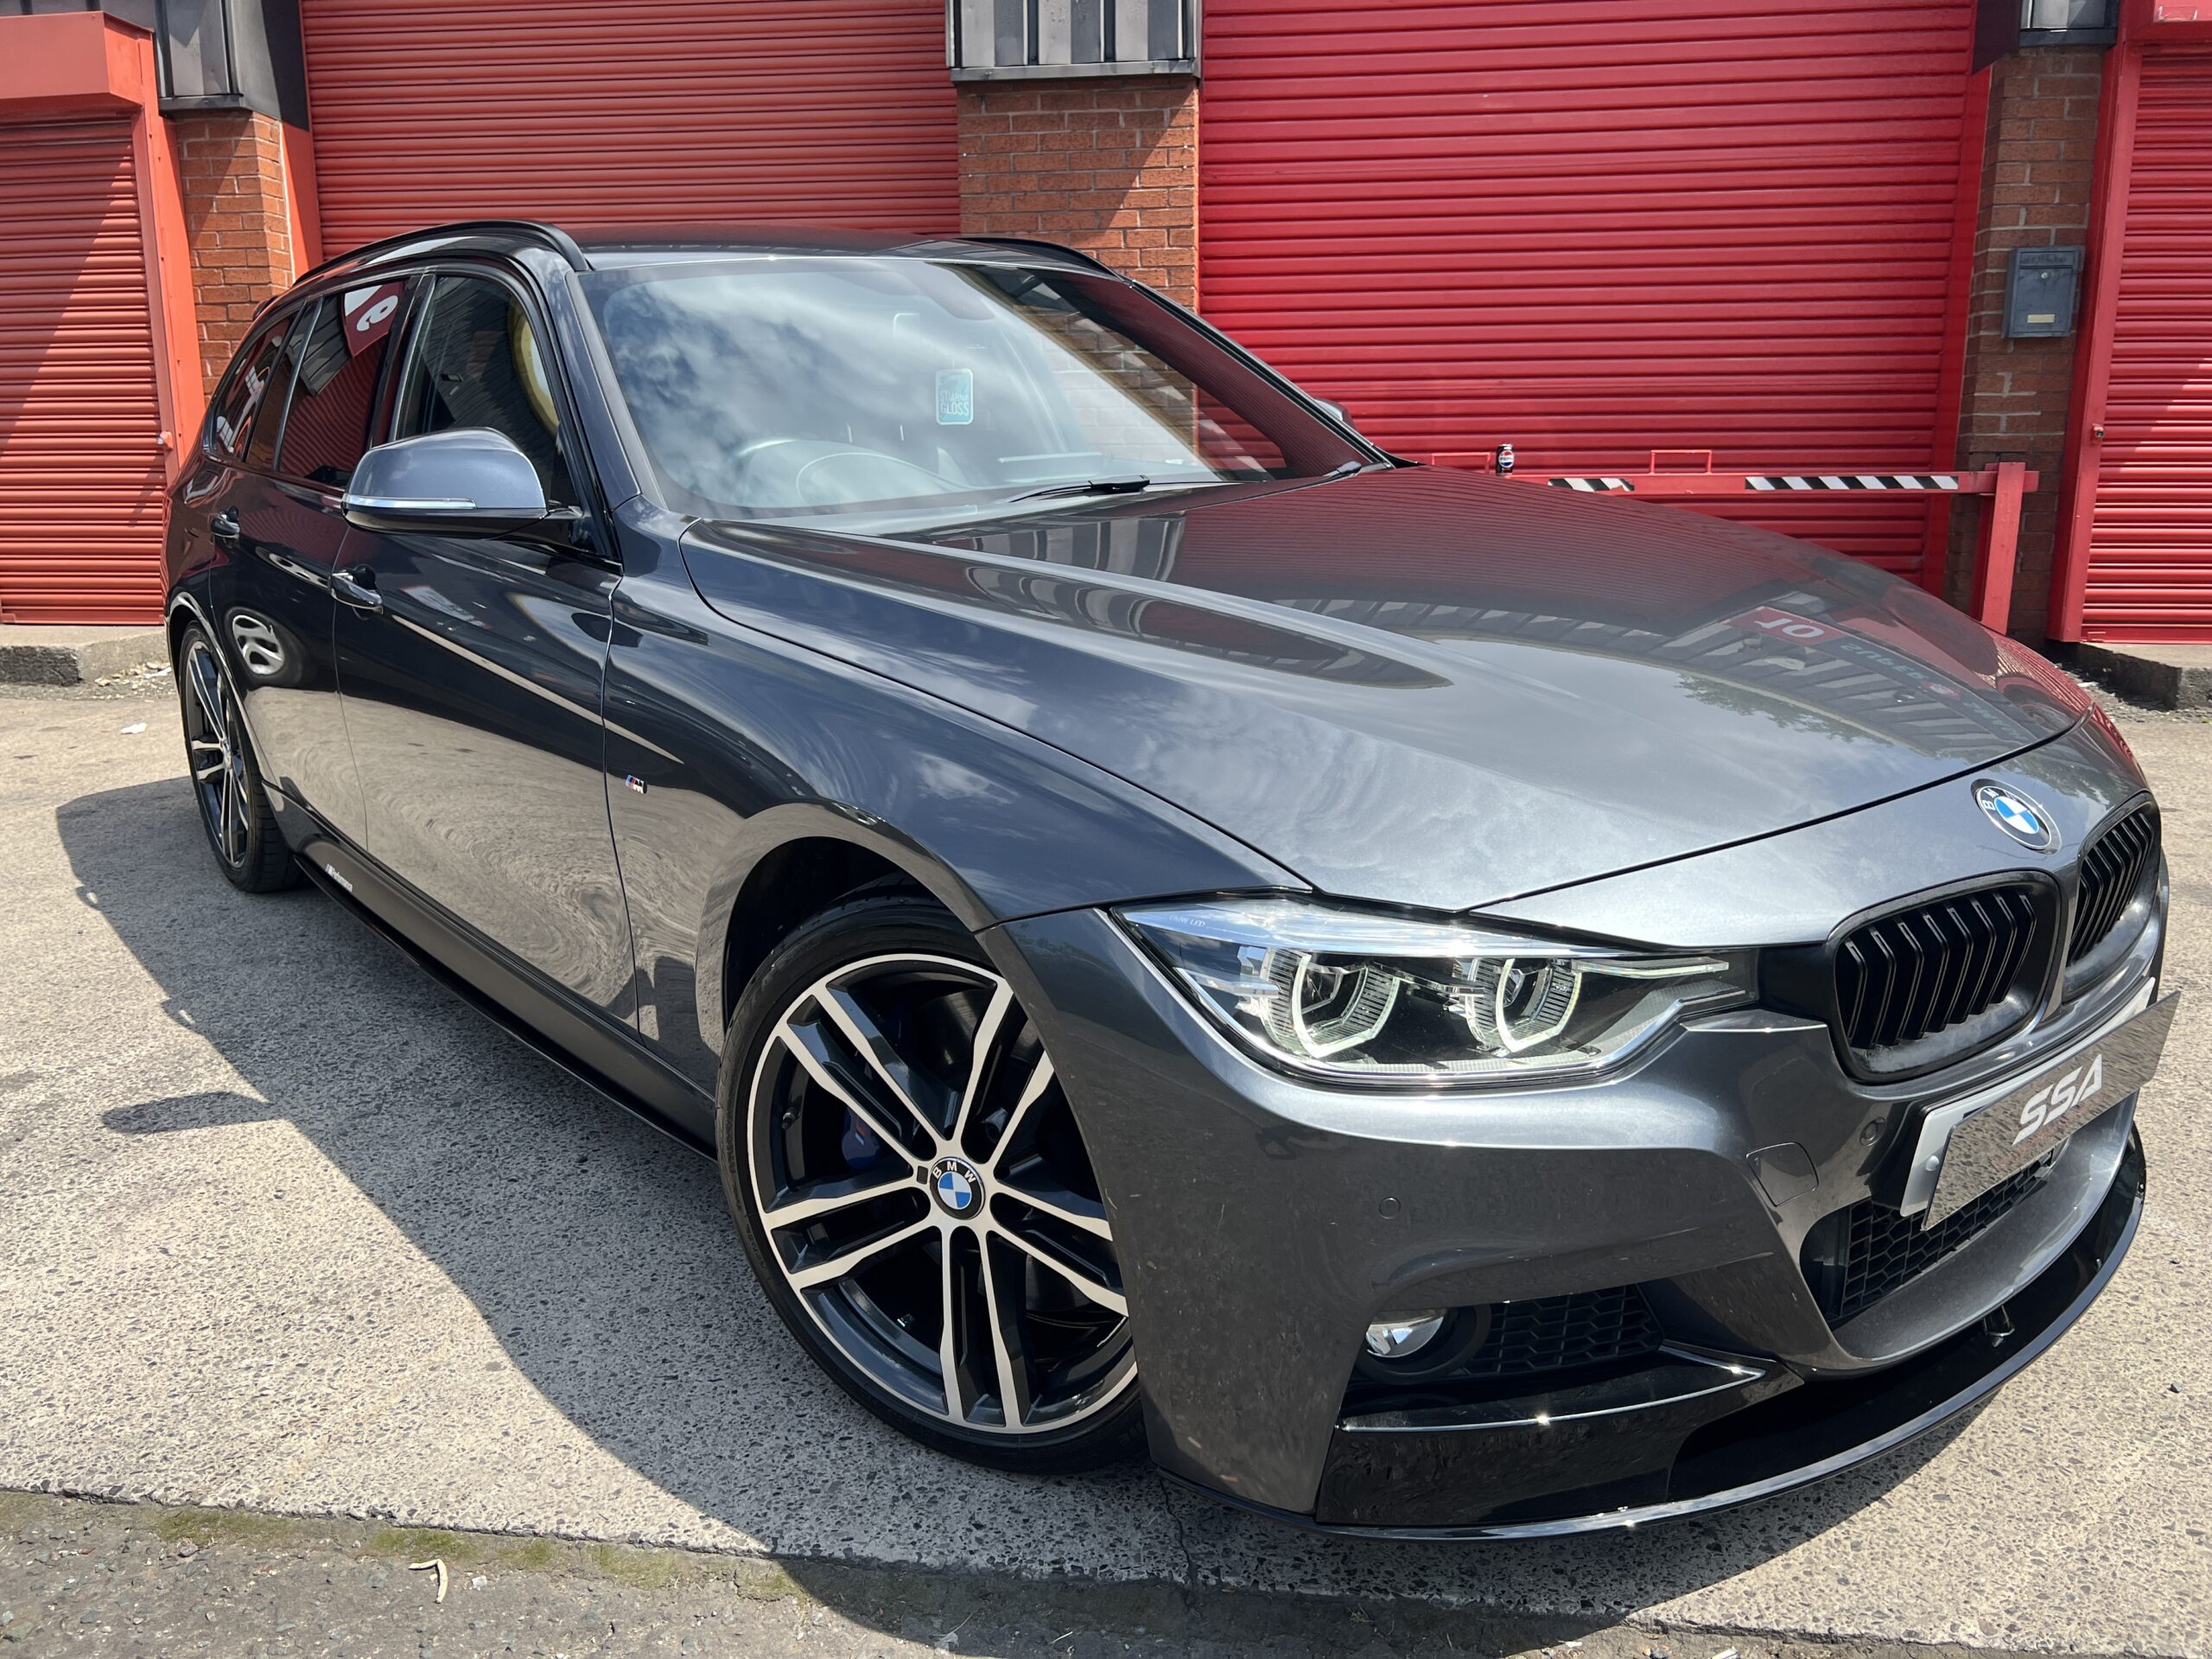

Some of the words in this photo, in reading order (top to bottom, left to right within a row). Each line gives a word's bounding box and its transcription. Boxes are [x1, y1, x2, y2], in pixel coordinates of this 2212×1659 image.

[941, 402, 969, 416] GLOSS
[2012, 1053, 2102, 1147] SSA
[932, 1161, 976, 1183] BMW
